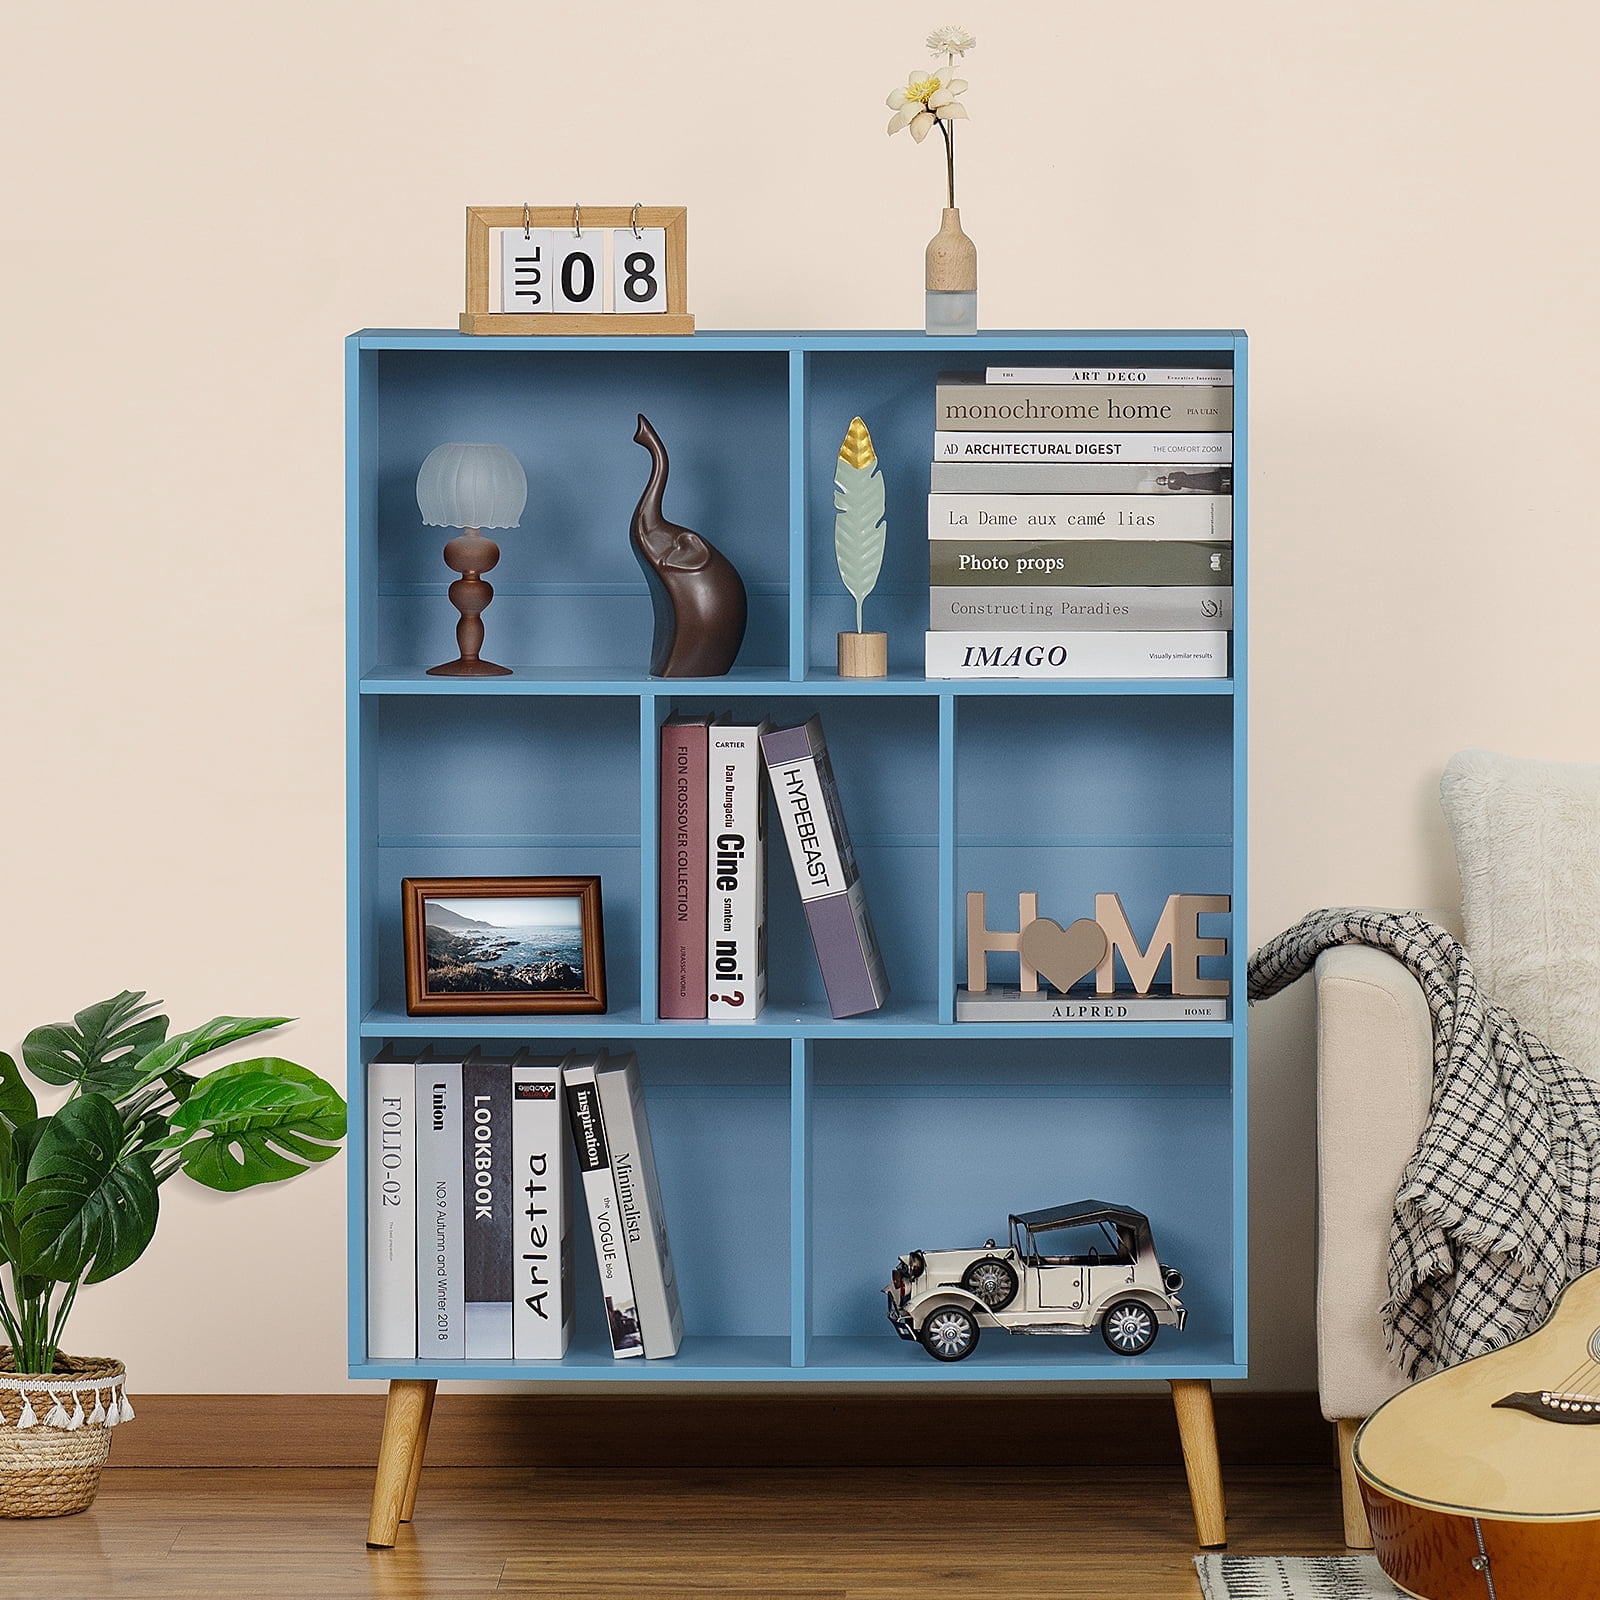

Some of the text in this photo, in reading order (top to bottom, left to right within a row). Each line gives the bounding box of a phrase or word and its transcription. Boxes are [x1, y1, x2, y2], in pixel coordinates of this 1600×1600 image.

[514, 246, 542, 305] JUL
[1071, 372, 1147, 381] ART DECO
[945, 399, 1172, 419] monochrome home
[943, 444, 1122, 455] AD ARCHITECTURAL DIGEST
[949, 511, 1156, 526] La Dame aux camé lias
[958, 554, 1065, 573] Photo props
[951, 602, 1130, 616] Constructing Paradies
[961, 646, 1068, 667] IMAGO
[1149, 652, 1172, 660] Visually
[723, 764, 736, 829] Dan Dungaciu
[677, 745, 689, 923] FION CROSSOVER COLLECTION
[783, 768, 830, 888] HYPEBEAST
[716, 833, 745, 892] Cine
[715, 940, 743, 981] noi
[966, 892, 1232, 996] HME
[1051, 1005, 1129, 1018] ALPRED
[1184, 1008, 1213, 1016] HOME
[382, 1096, 402, 1207] FOLIO-02
[473, 1095, 494, 1220] LOOKBOOK
[576, 1090, 600, 1168] inspiration
[431, 1082, 449, 1341] Union NO.9 Autumn and Winter 2018
[614, 1153, 642, 1243] Minimalista
[522, 1152, 549, 1320] Arletta
[597, 1197, 617, 1279] the VOGUE blog
